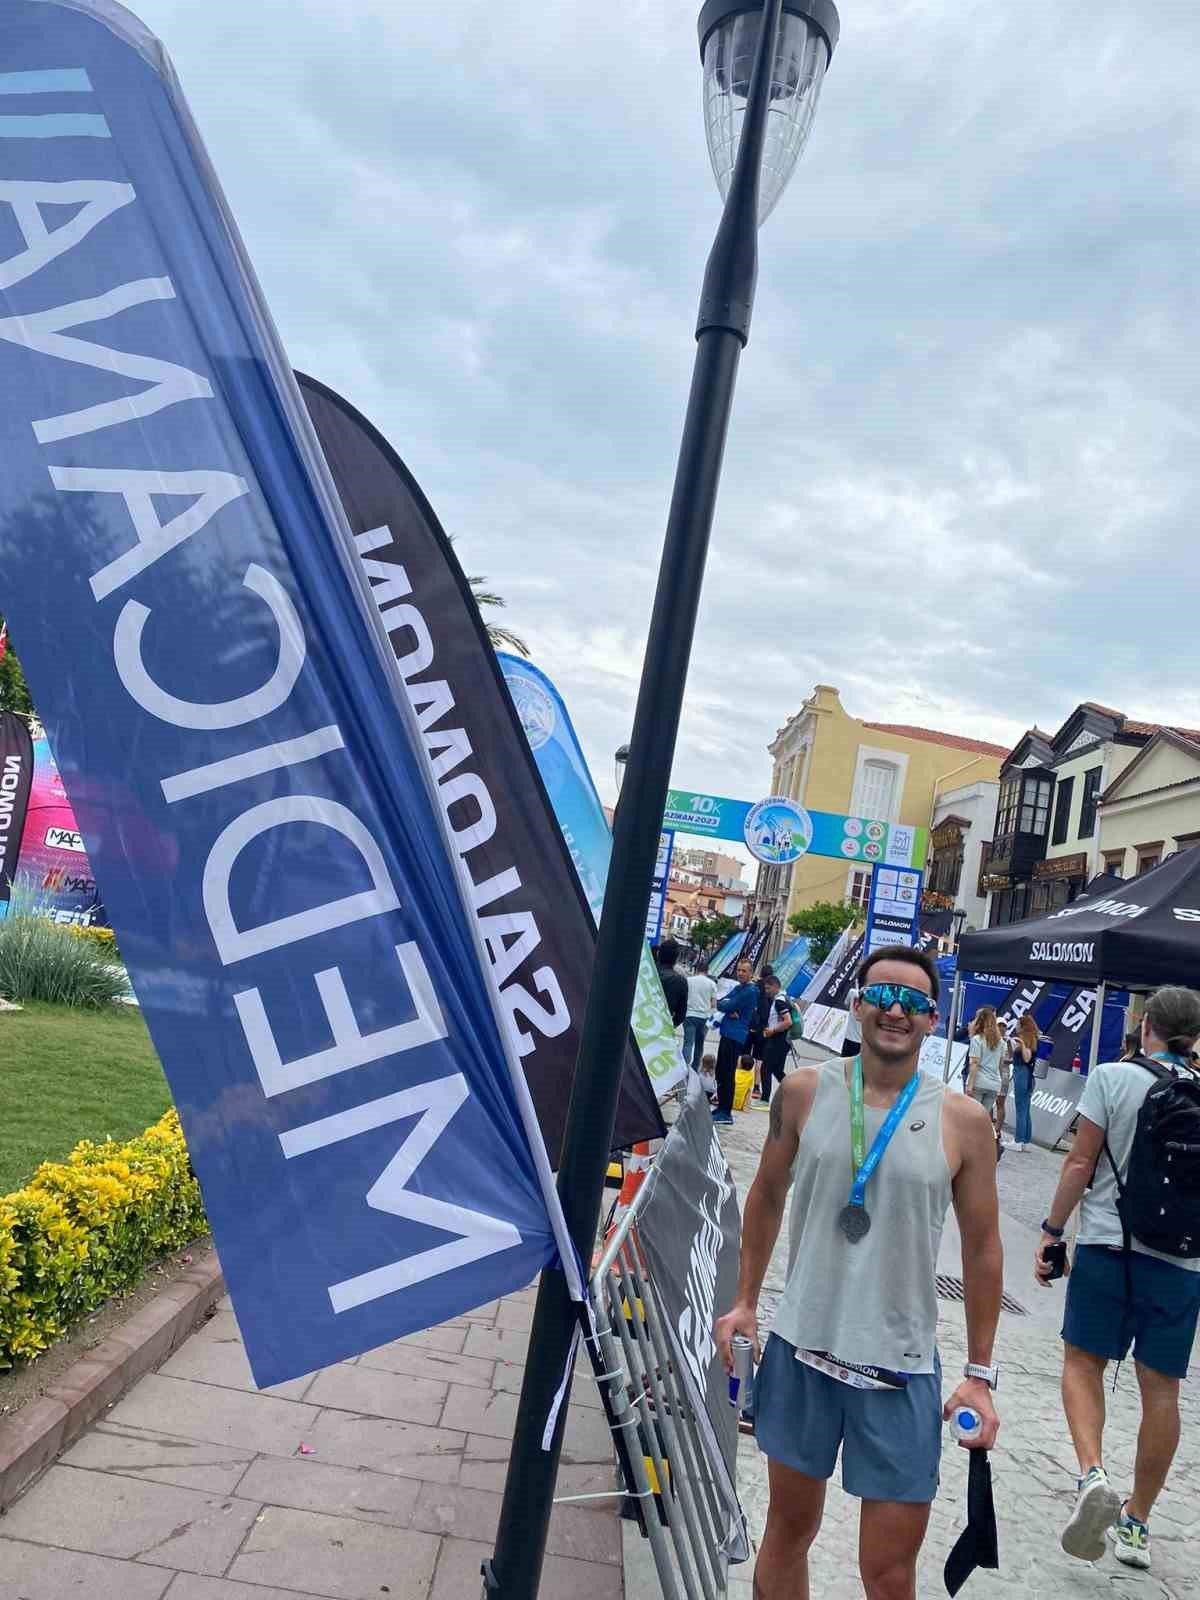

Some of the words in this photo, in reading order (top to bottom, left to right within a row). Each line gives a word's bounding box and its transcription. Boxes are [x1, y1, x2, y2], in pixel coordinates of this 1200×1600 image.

[690, 796, 723, 816] 10K
[875, 918, 911, 929] SALOMON
[1029, 941, 1095, 963] SALOMON
[1003, 980, 1046, 1037] SAL
